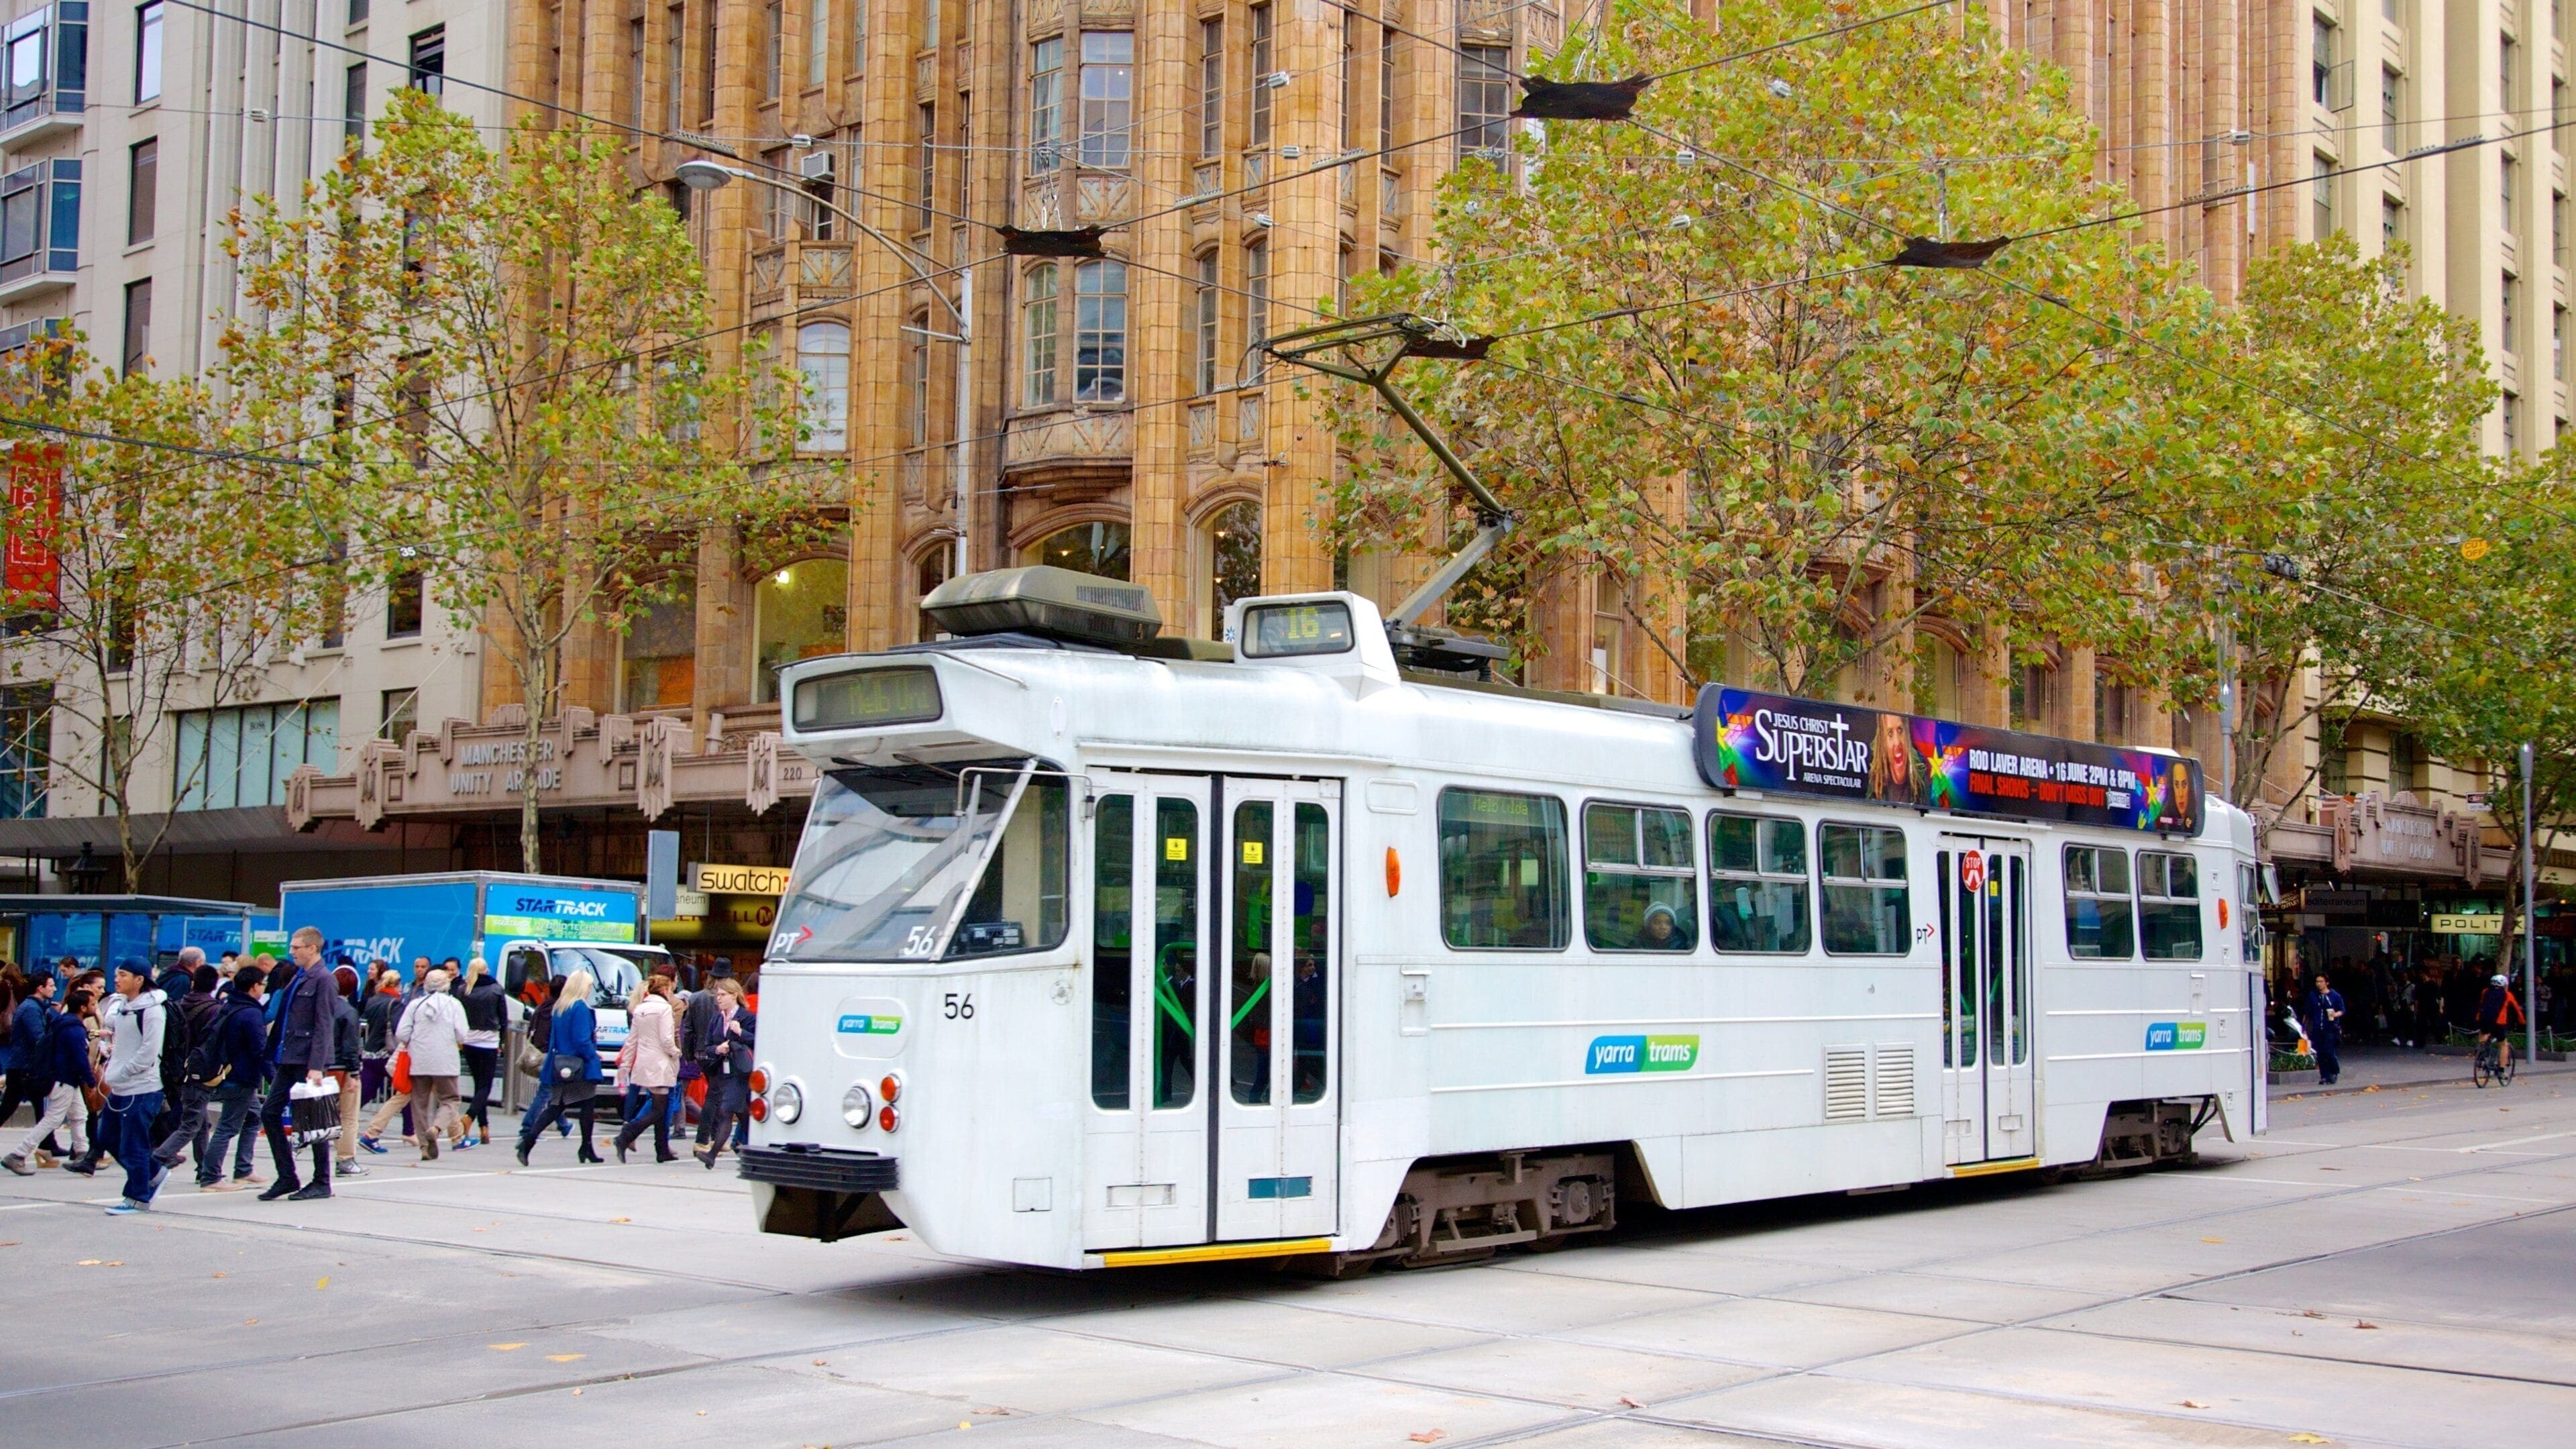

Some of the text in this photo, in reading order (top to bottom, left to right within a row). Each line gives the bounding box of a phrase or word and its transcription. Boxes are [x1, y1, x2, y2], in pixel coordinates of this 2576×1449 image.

[2465, 540, 2482, 549] CUT
[2466, 549, 2485, 557] OFF
[1287, 606, 1319, 639] 16
[1773, 713, 1829, 734] JESUS CHRIST
[462, 739, 554, 765] MANCHESER
[1755, 708, 1868, 780] SUPERSTAR
[784, 767, 802, 780] 220
[1969, 749, 2136, 790] ROD LAVER ARENA 16 JUNE 2PM & 8PM
[451, 767, 562, 794] UNITY ARADE
[1803, 772, 1862, 788] ARENA SPECTACULAR
[1969, 773, 1994, 794] FINAL
[1996, 776, 2029, 799] SHOWS
[2039, 782, 2063, 803] DON'T
[2066, 784, 2087, 804] MISS
[2089, 787, 2105, 807] OUT
[2385, 818, 2432, 837] MANCHESTER
[1966, 857, 1981, 869] STOP
[700, 869, 781, 892] swatch
[516, 898, 608, 917] STARTRACK
[2440, 919, 2523, 928] POLITX
[188, 928, 241, 944] STARTR
[771, 933, 800, 953] PT
[904, 926, 937, 955] 56
[1917, 928, 1927, 945] PT
[323, 938, 405, 964] ARTRACK
[945, 993, 974, 1020] 56
[2150, 1027, 2202, 1046] yarra trams
[1595, 1042, 1691, 1069] yarra trams
